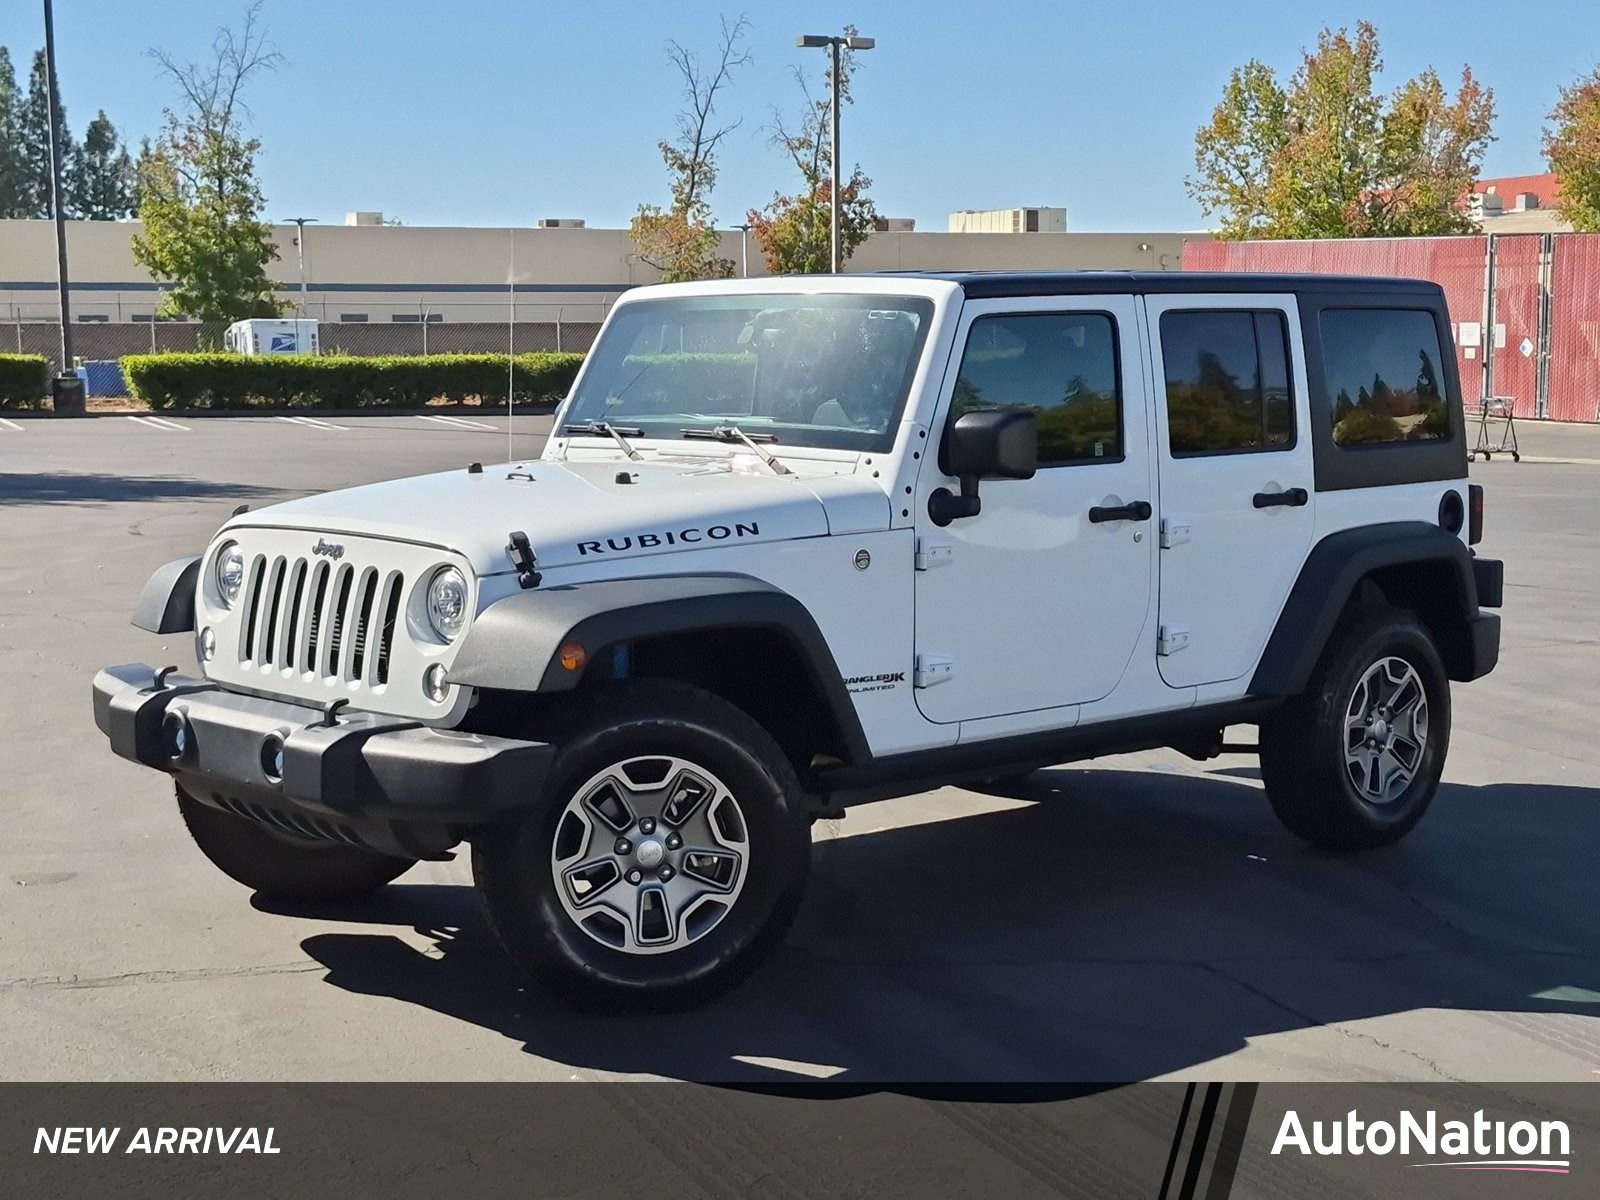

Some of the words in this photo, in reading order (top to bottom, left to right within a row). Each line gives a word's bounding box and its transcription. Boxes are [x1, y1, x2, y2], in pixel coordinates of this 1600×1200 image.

[312, 537, 344, 561] Jeep
[576, 522, 760, 555] RUBICON
[848, 684, 895, 693] NLIMITED
